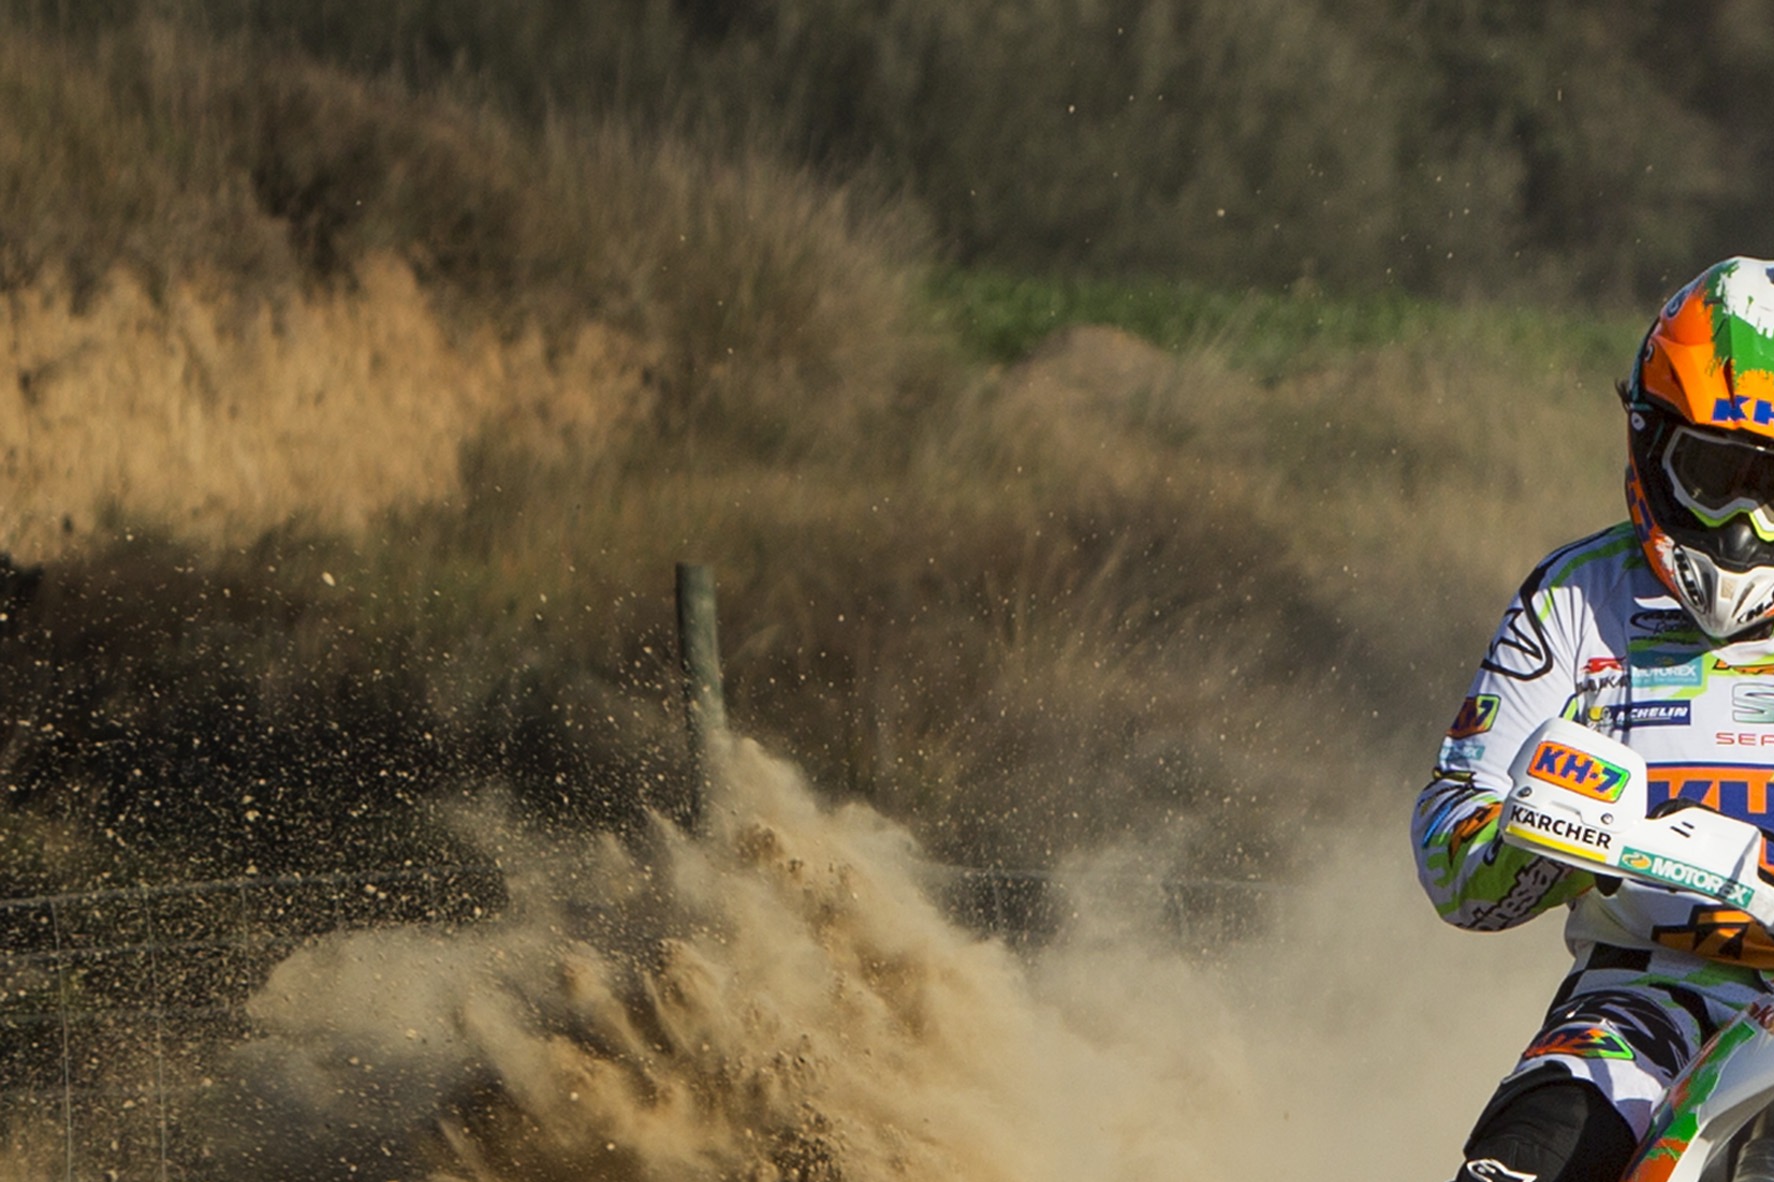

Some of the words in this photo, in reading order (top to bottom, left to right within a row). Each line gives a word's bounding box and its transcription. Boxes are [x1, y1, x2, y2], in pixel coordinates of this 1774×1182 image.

[1535, 746, 1622, 793] KH-7
[1510, 805, 1612, 849] KÄRCHER
[1651, 857, 1750, 905] MOTOREX
